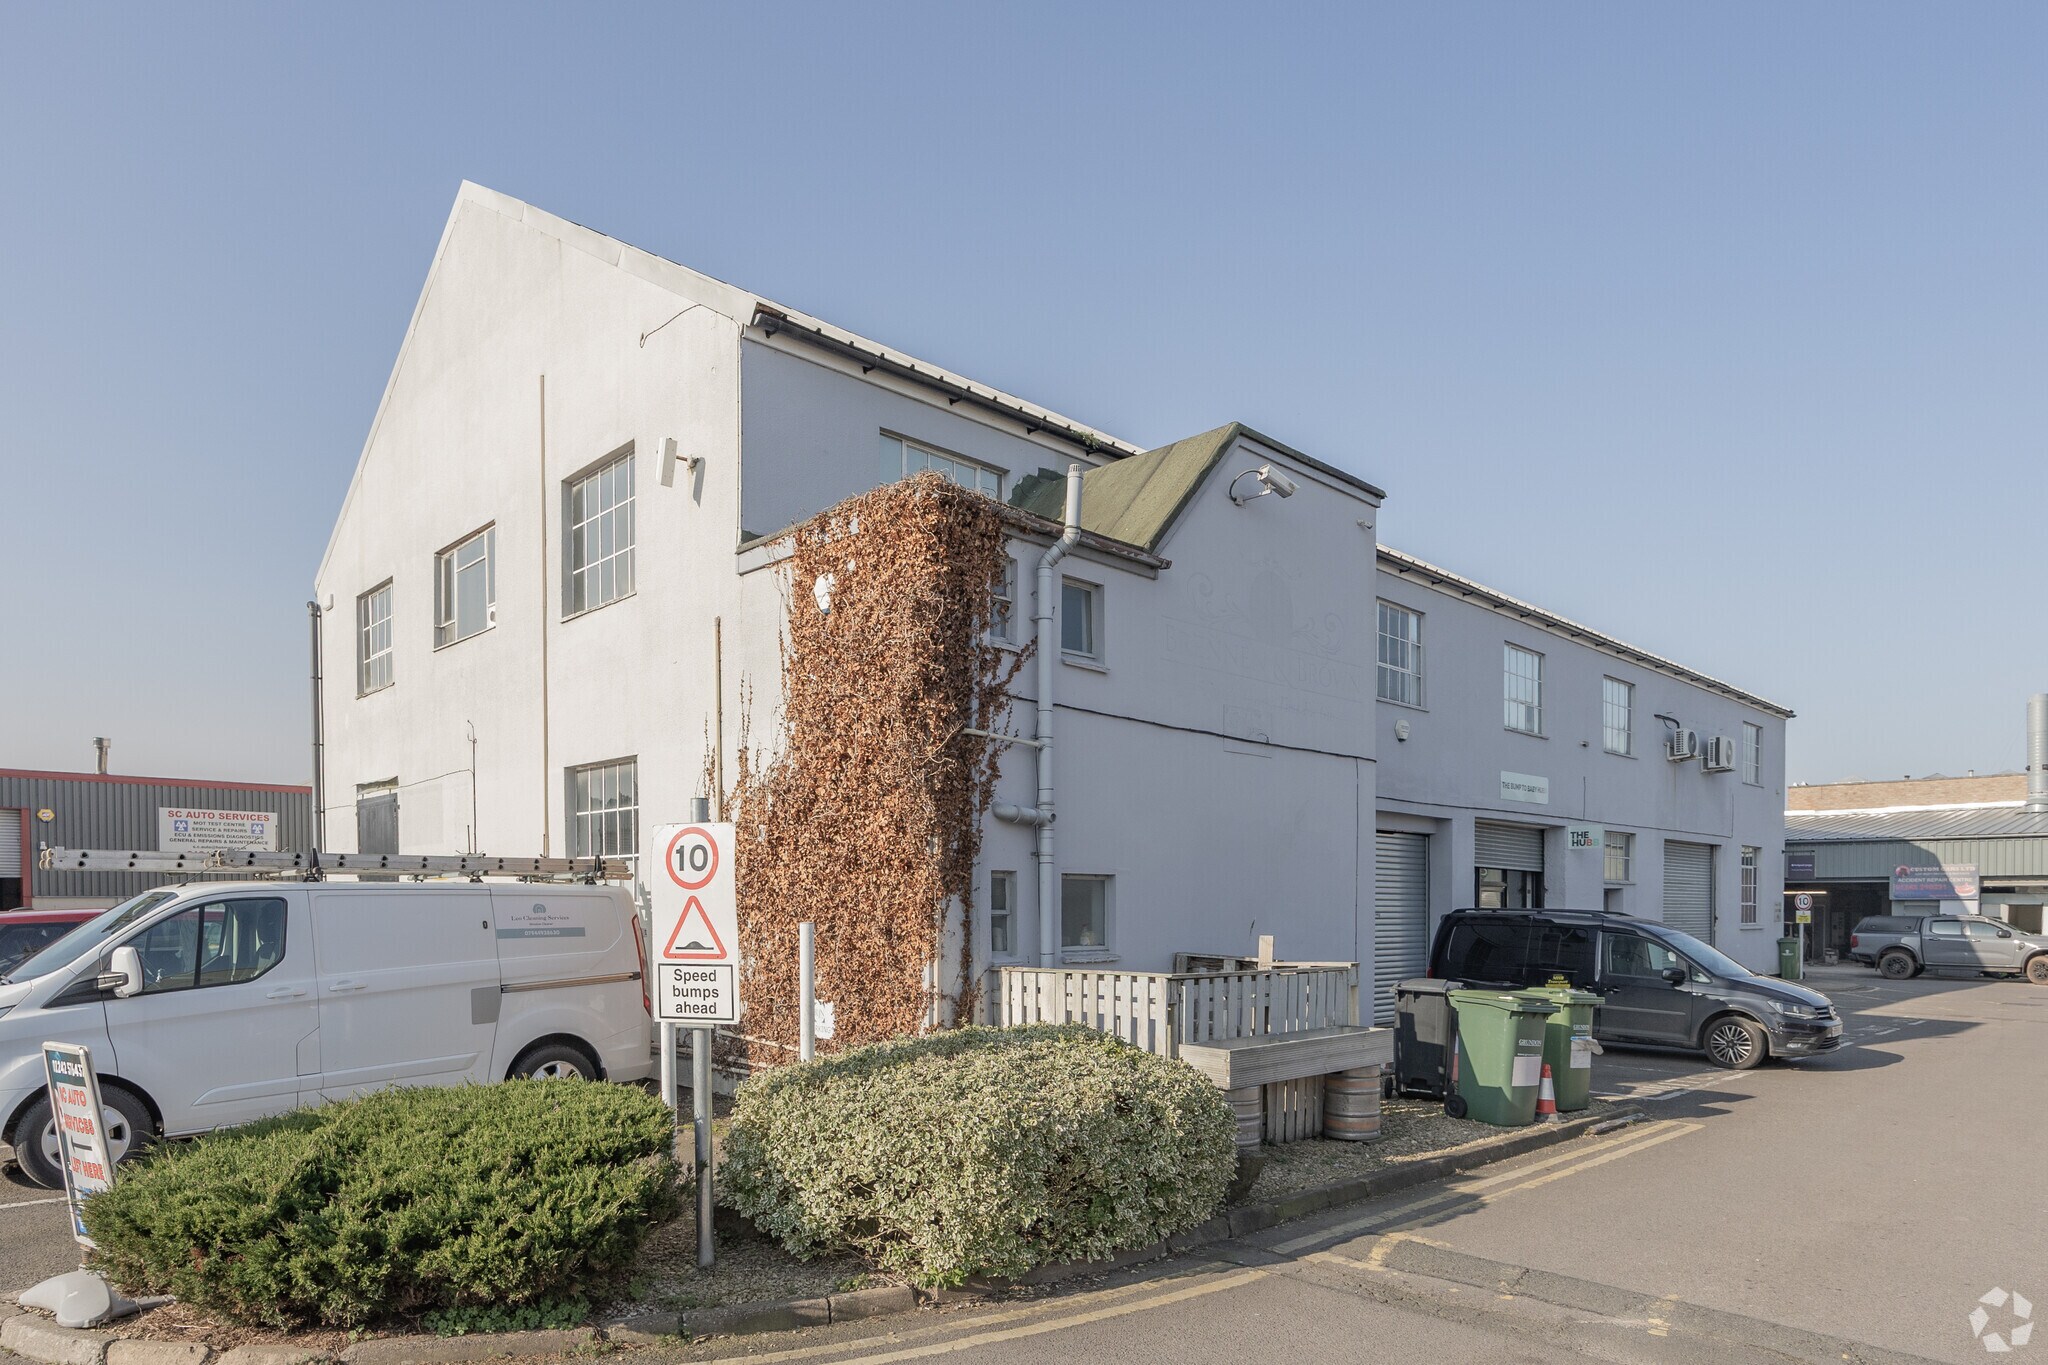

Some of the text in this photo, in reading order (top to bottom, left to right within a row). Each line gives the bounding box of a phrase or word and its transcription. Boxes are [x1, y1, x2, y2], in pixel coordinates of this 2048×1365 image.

[168, 810, 270, 822] SC AUTO SERVICES
[676, 844, 709, 871] 10
[1798, 898, 1809, 906] 10
[674, 969, 717, 985] Speed
[672, 985, 719, 1000] bumps
[675, 1002, 717, 1015] ahead
[68, 1089, 87, 1107] AUTO
[82, 1161, 105, 1180] HERE
